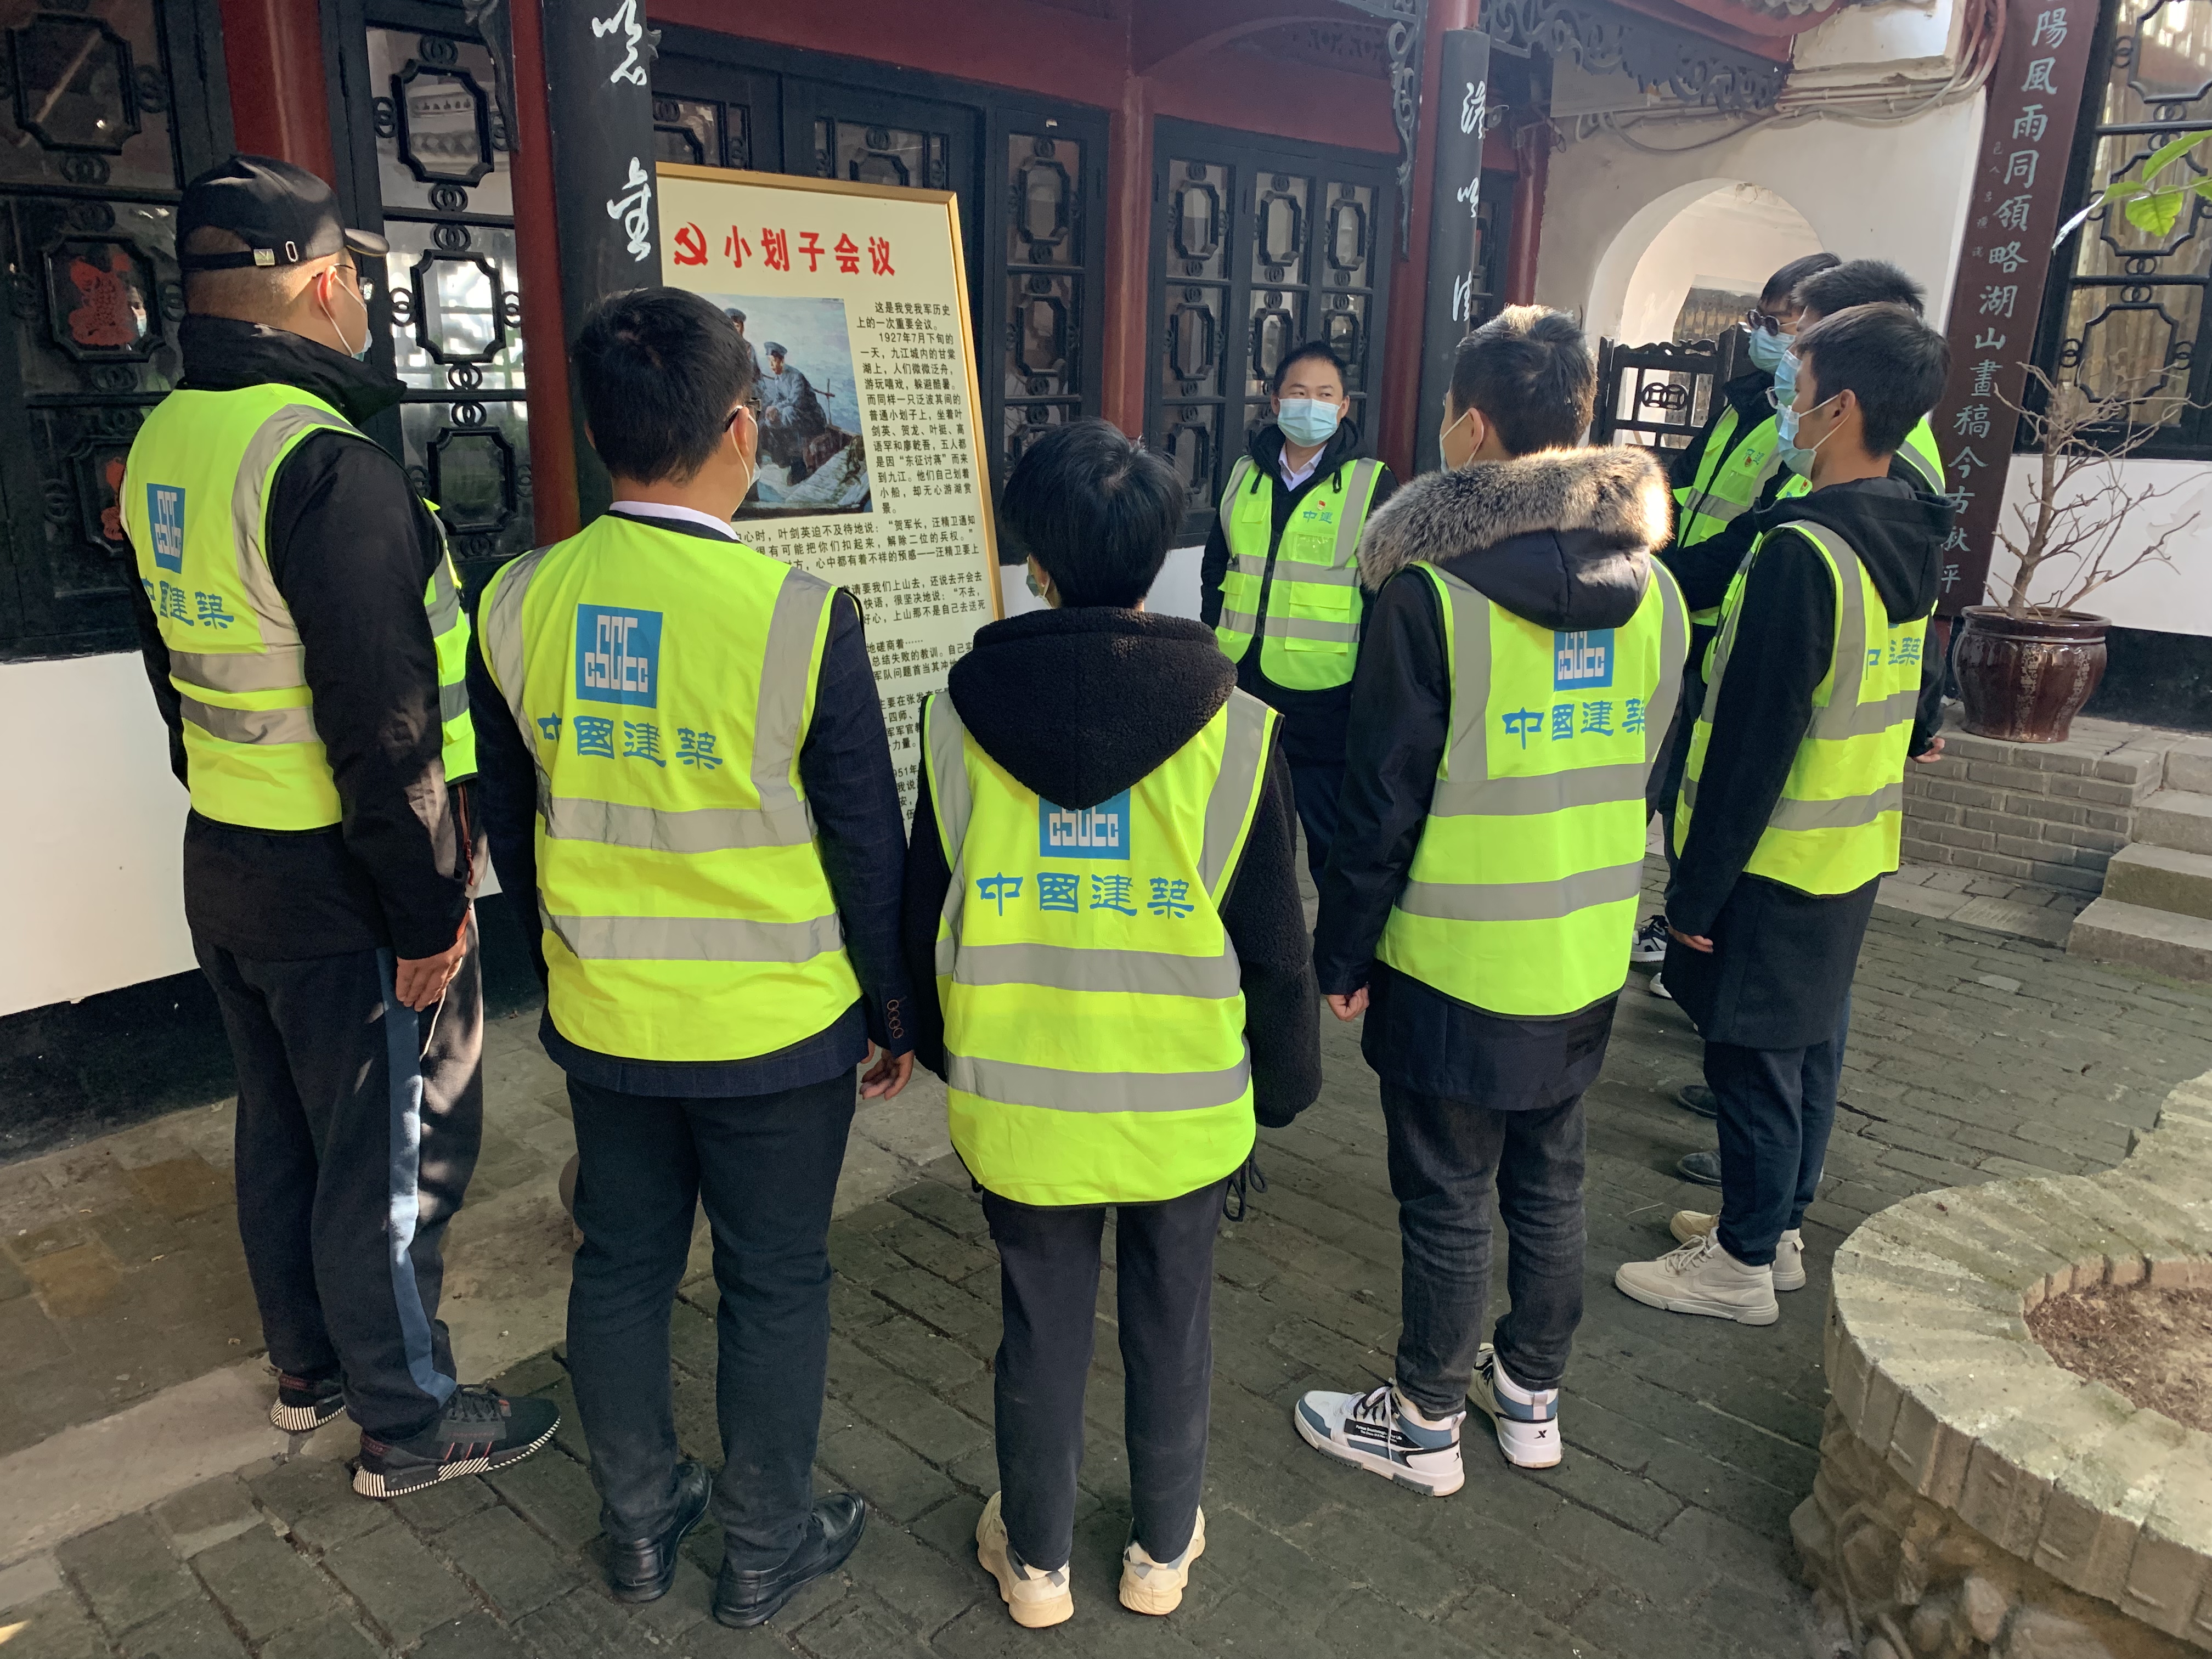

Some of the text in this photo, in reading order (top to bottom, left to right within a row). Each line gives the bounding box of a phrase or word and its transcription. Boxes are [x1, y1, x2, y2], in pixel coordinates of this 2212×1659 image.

[724, 225, 895, 276] 小划子会议
[875, 301, 950, 316] 这是我党我军历史
[857, 317, 938, 331] 上的一次重要会议。
[879, 331, 954, 345] 1927年7月下旬的
[860, 347, 956, 360] 一天，九江城内的甘棠
[862, 362, 953, 376] 湖上，人们微微泛舟，
[865, 377, 956, 391] 游玩嘻戏，躲避酷暑。
[867, 393, 961, 407] 而同样一只泛波其间的
[869, 409, 963, 422] 普通小划子上，坐着叶
[871, 423, 964, 437] 剑英、贺龙、叶挺、高
[873, 438, 967, 452] 语罕和廖乾吾，五人都
[876, 453, 968, 468] 是因“东征讨蒋”而来
[878, 468, 969, 483] 到九江。他们自己划着
[880, 483, 972, 499] 小船，却无心游湖赏
[882, 502, 896, 515] 景。
[864, 599, 986, 625] 好心，上山那不是自己去送死
